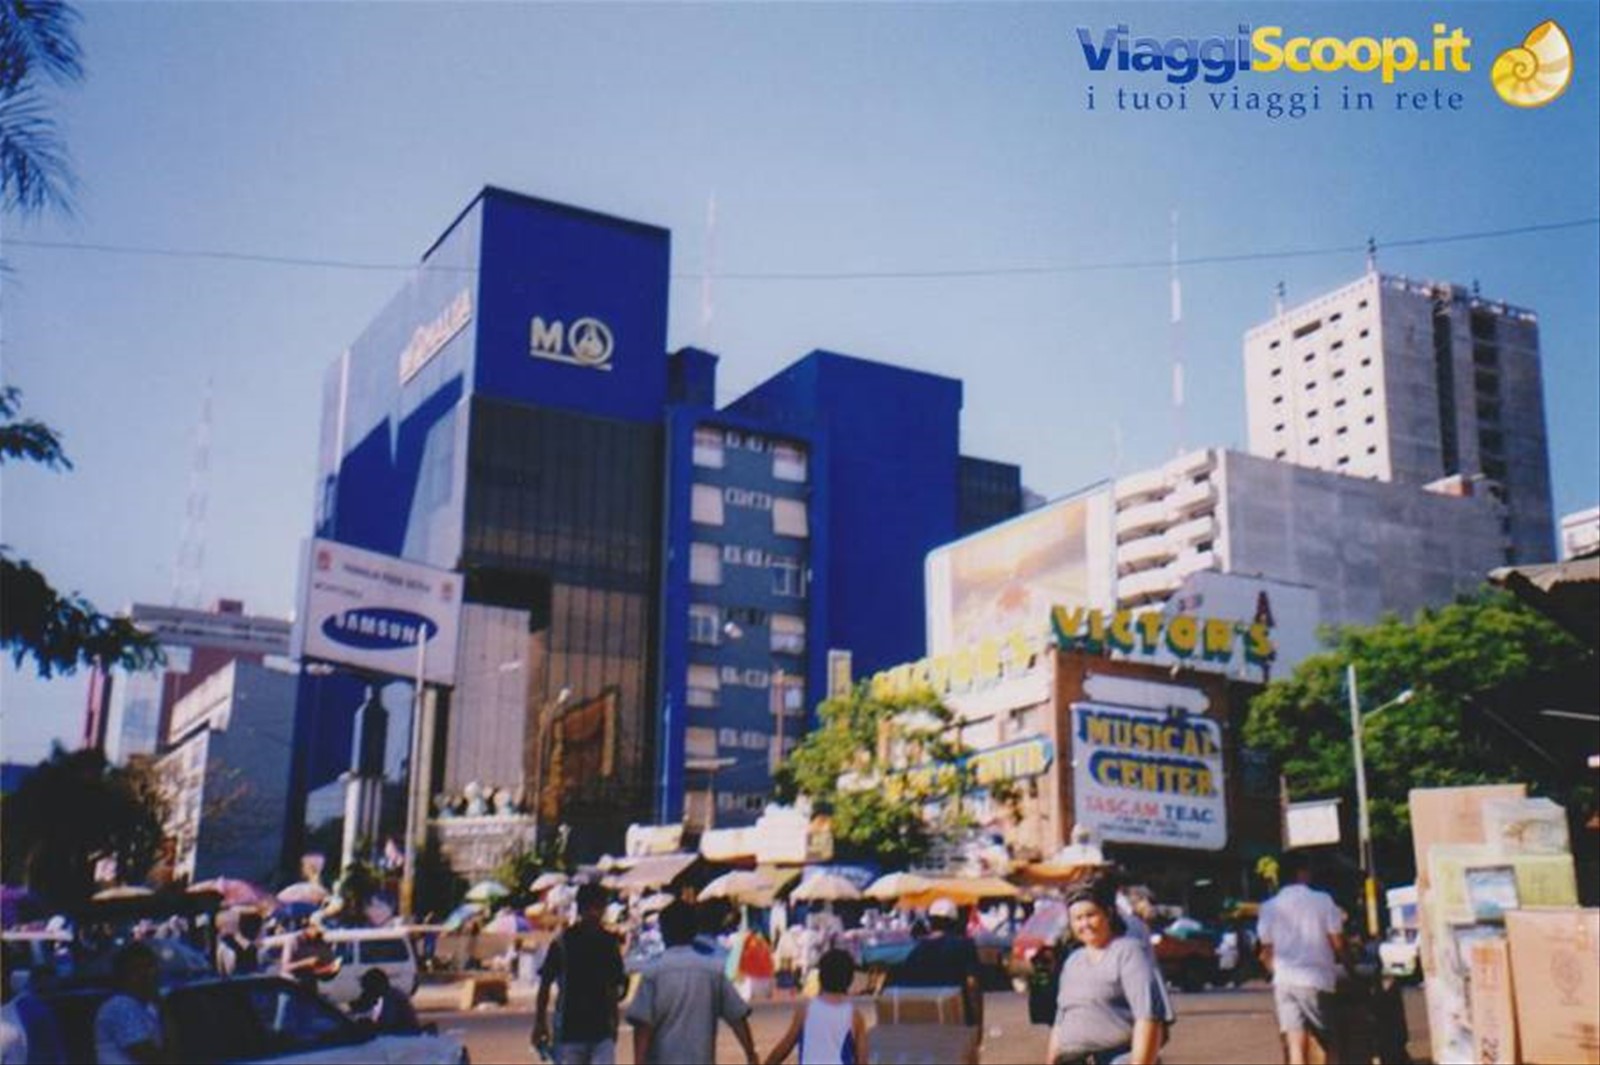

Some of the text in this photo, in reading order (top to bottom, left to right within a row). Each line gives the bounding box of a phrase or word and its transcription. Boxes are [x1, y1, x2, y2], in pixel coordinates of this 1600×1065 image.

[334, 609, 428, 645] SAMSUN
[1052, 604, 1273, 663] VICTOR'S
[1096, 756, 1215, 797] CENTER
[1164, 804, 1214, 824] TEAC
